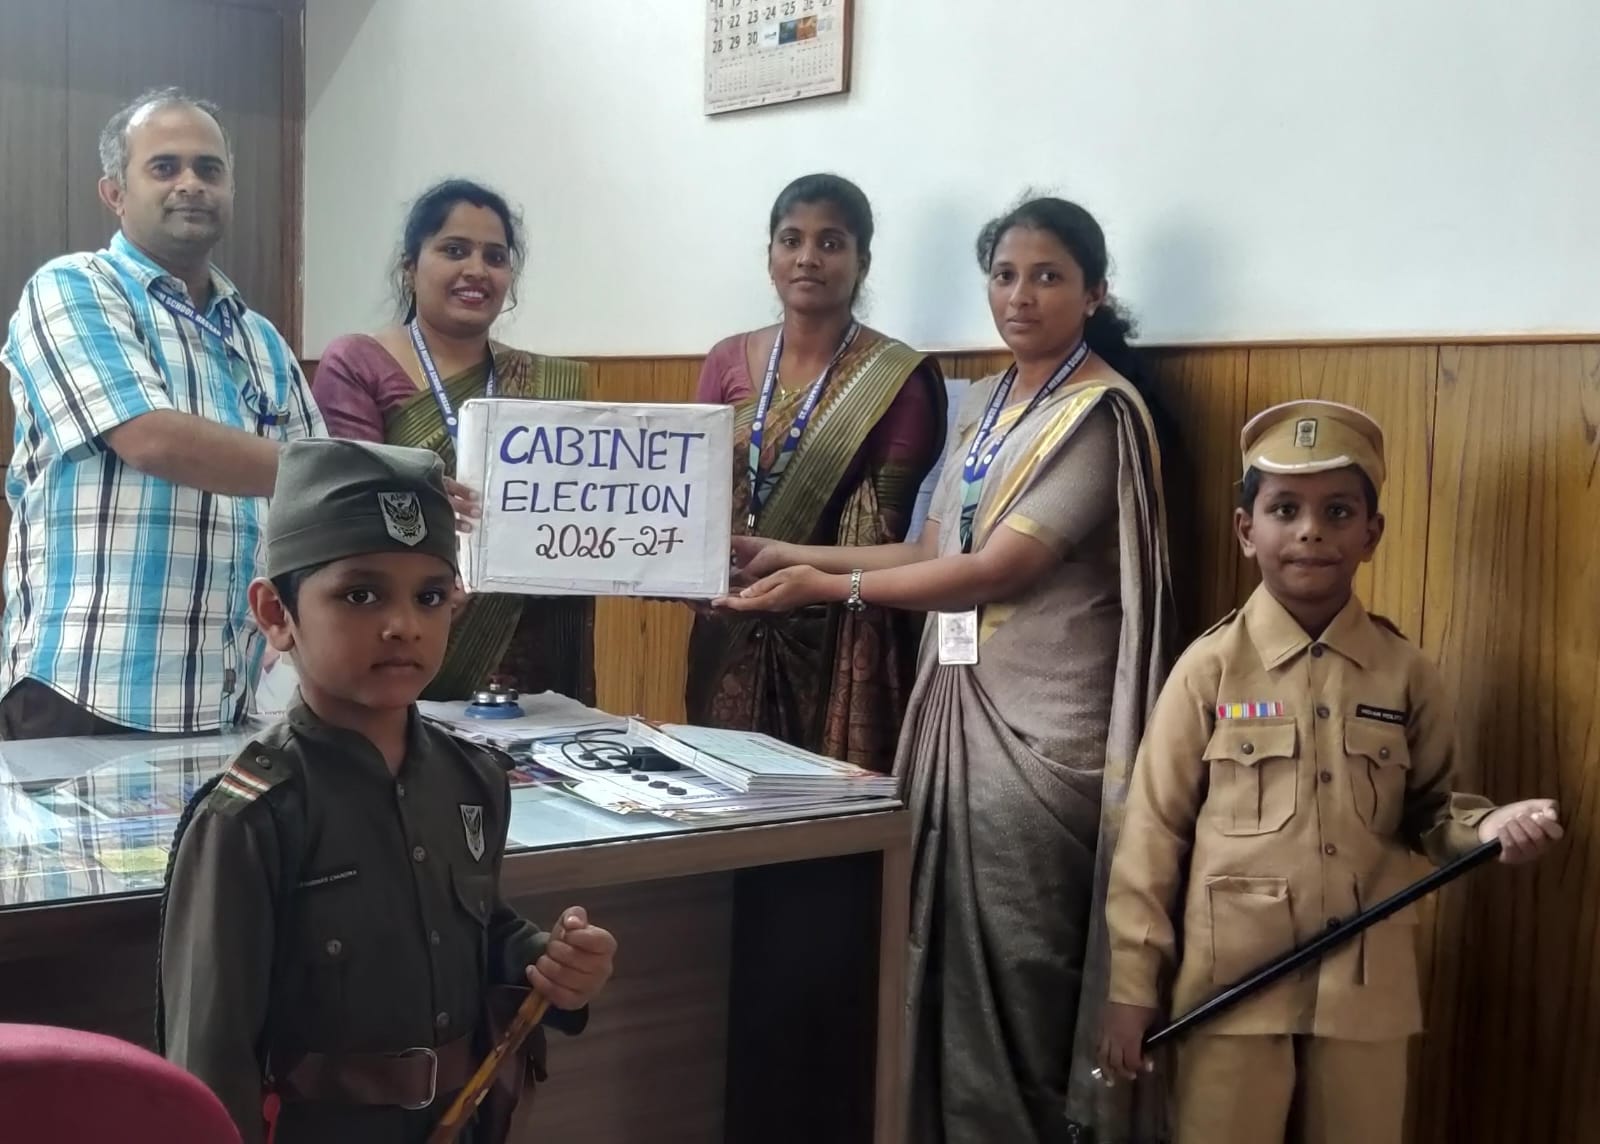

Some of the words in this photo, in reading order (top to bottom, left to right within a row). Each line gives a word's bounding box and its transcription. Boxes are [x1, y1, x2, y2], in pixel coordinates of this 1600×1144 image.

[714, 18, 724, 33] 21
[730, 14, 741, 29] 22
[748, 10, 759, 24] 23
[765, 6, 777, 20] 24
[784, 1, 796, 16] 25
[712, 39, 723, 53] 28
[730, 35, 741, 50] 29
[747, 31, 758, 46] 30
[500, 425, 704, 474] CABINET
[501, 480, 690, 518] ELECTION
[535, 523, 684, 559] 2026-27
